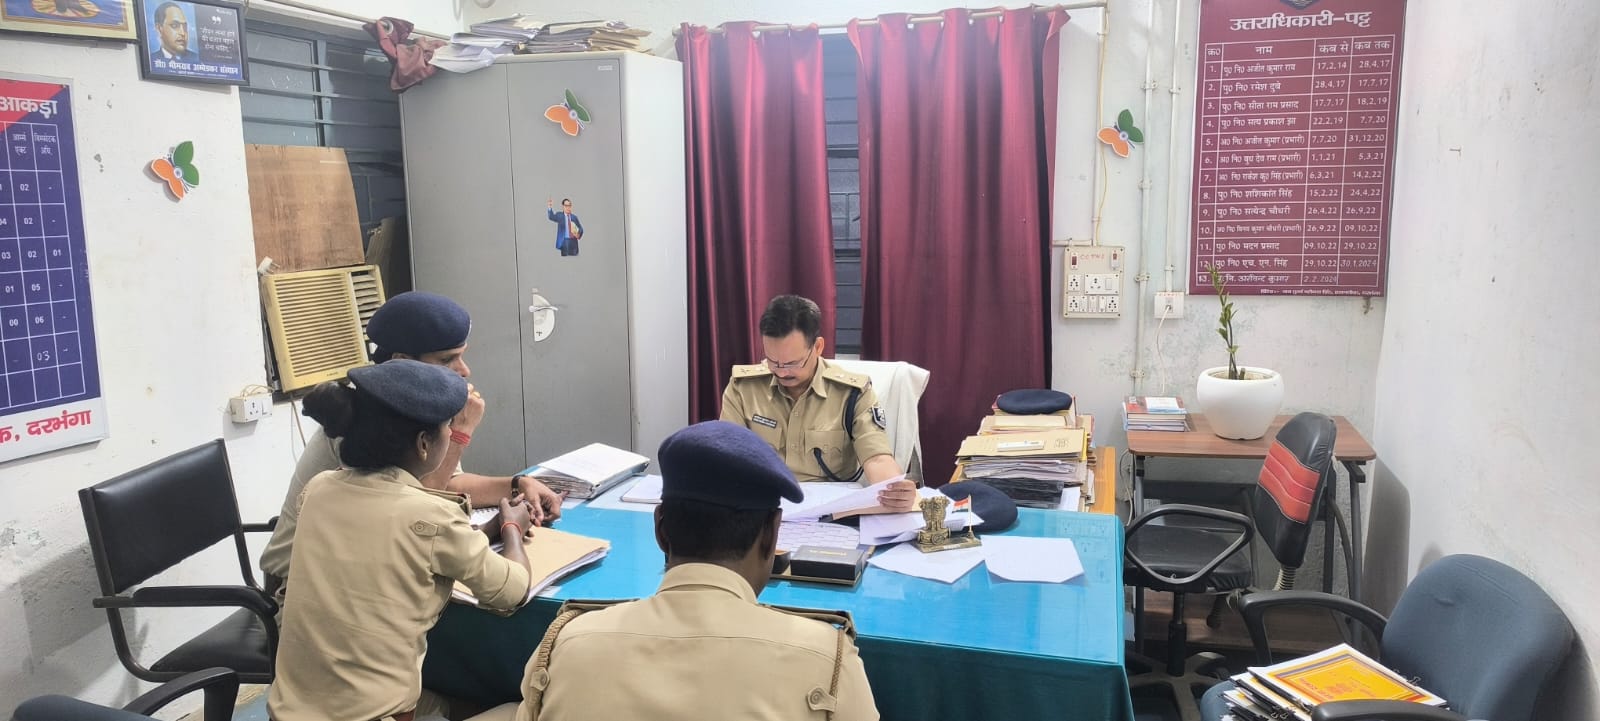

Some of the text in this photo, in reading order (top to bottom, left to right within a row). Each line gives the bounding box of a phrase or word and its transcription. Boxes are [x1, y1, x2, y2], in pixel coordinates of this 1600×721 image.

[1256, 46, 1273, 54] नाम
[1318, 44, 1337, 53] कब
[1340, 42, 1349, 52] से
[1354, 41, 1371, 50] कब
[1374, 40, 1390, 49] तक
[1264, 118, 1284, 126] प्रकाश
[20, 184, 30, 192] 02
[24, 217, 33, 225] 02
[1, 251, 11, 259] 03
[27, 250, 38, 258] 02
[5, 285, 14, 293] 01
[31, 283, 41, 291] 05
[34, 316, 45, 324] 06
[36, 350, 50, 361] 03
[26, 409, 92, 436] दरभंगा
